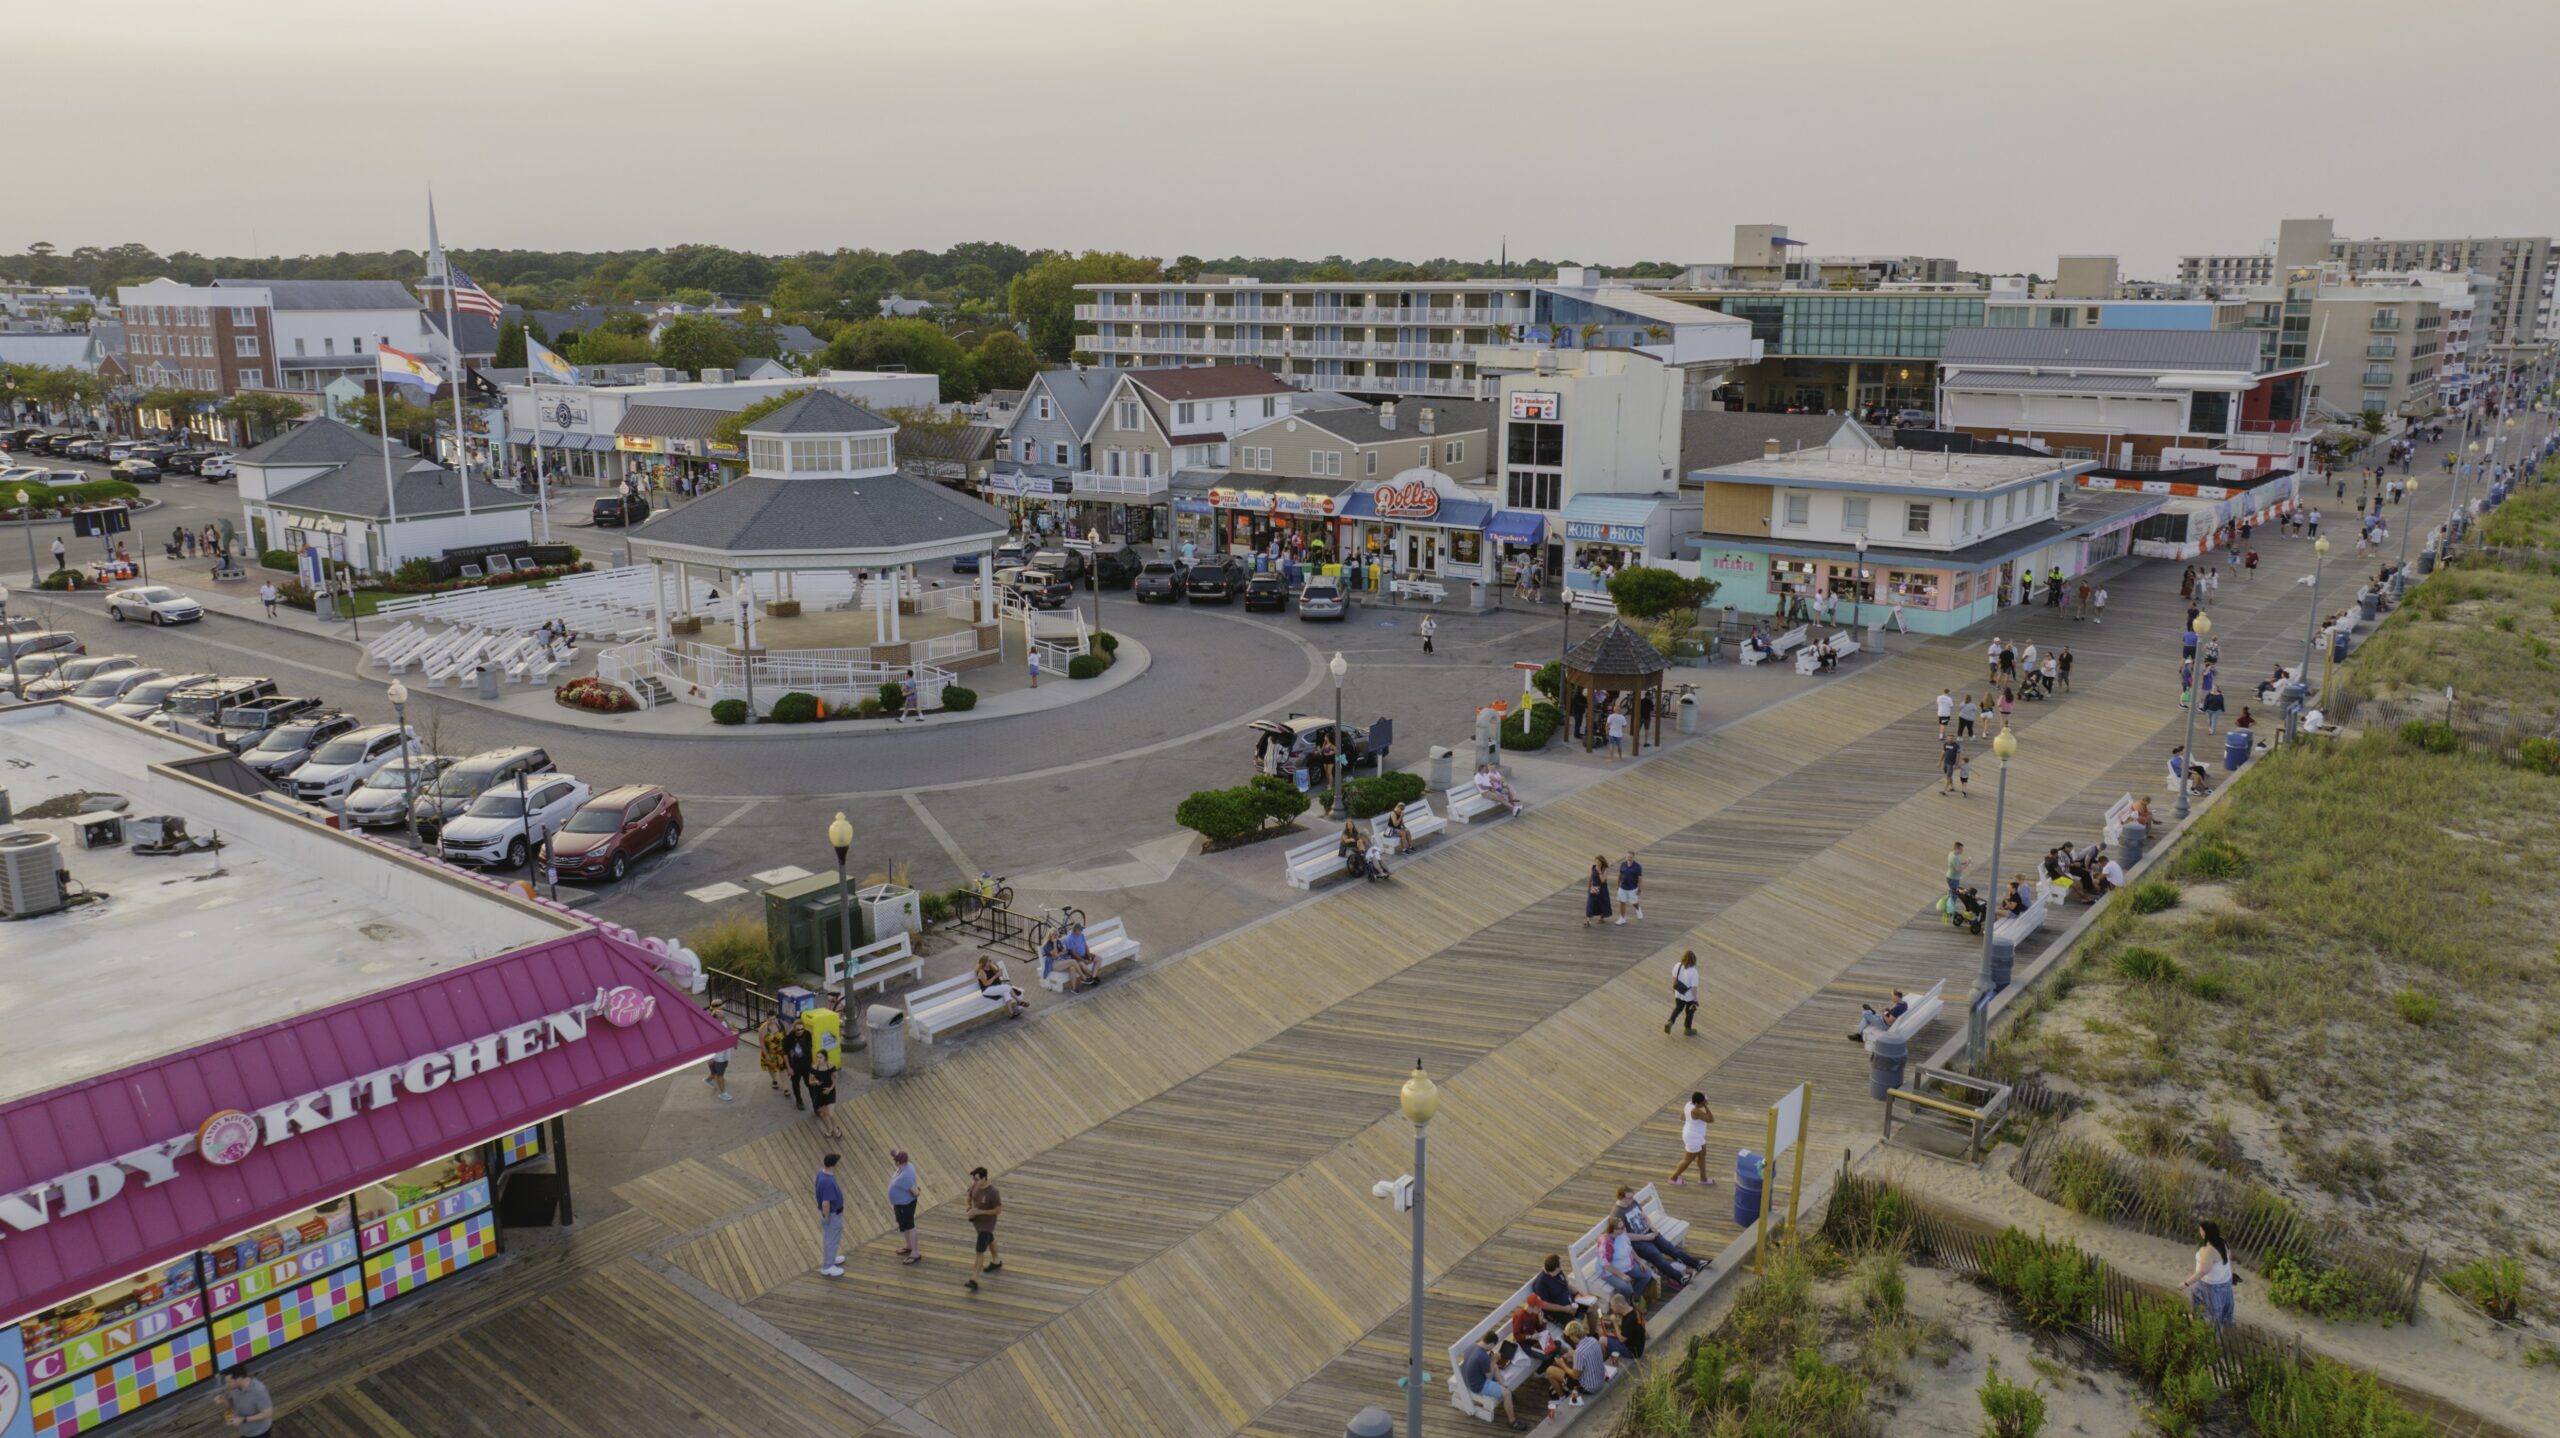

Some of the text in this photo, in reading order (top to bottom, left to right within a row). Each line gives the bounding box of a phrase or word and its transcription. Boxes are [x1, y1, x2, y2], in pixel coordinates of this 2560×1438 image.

[1514, 396, 1554, 405] Thrasher's
[1220, 495, 1239, 503] PIZZA
[1489, 533, 1528, 543] Thrasher's
[1567, 523, 1643, 542] KOHR BROS
[264, 1008, 588, 1145] KITCHEN
[205, 1115, 254, 1146] CANDY KITCHEN
[32, 1185, 485, 1379] CANDY FUDGE TAFFY
